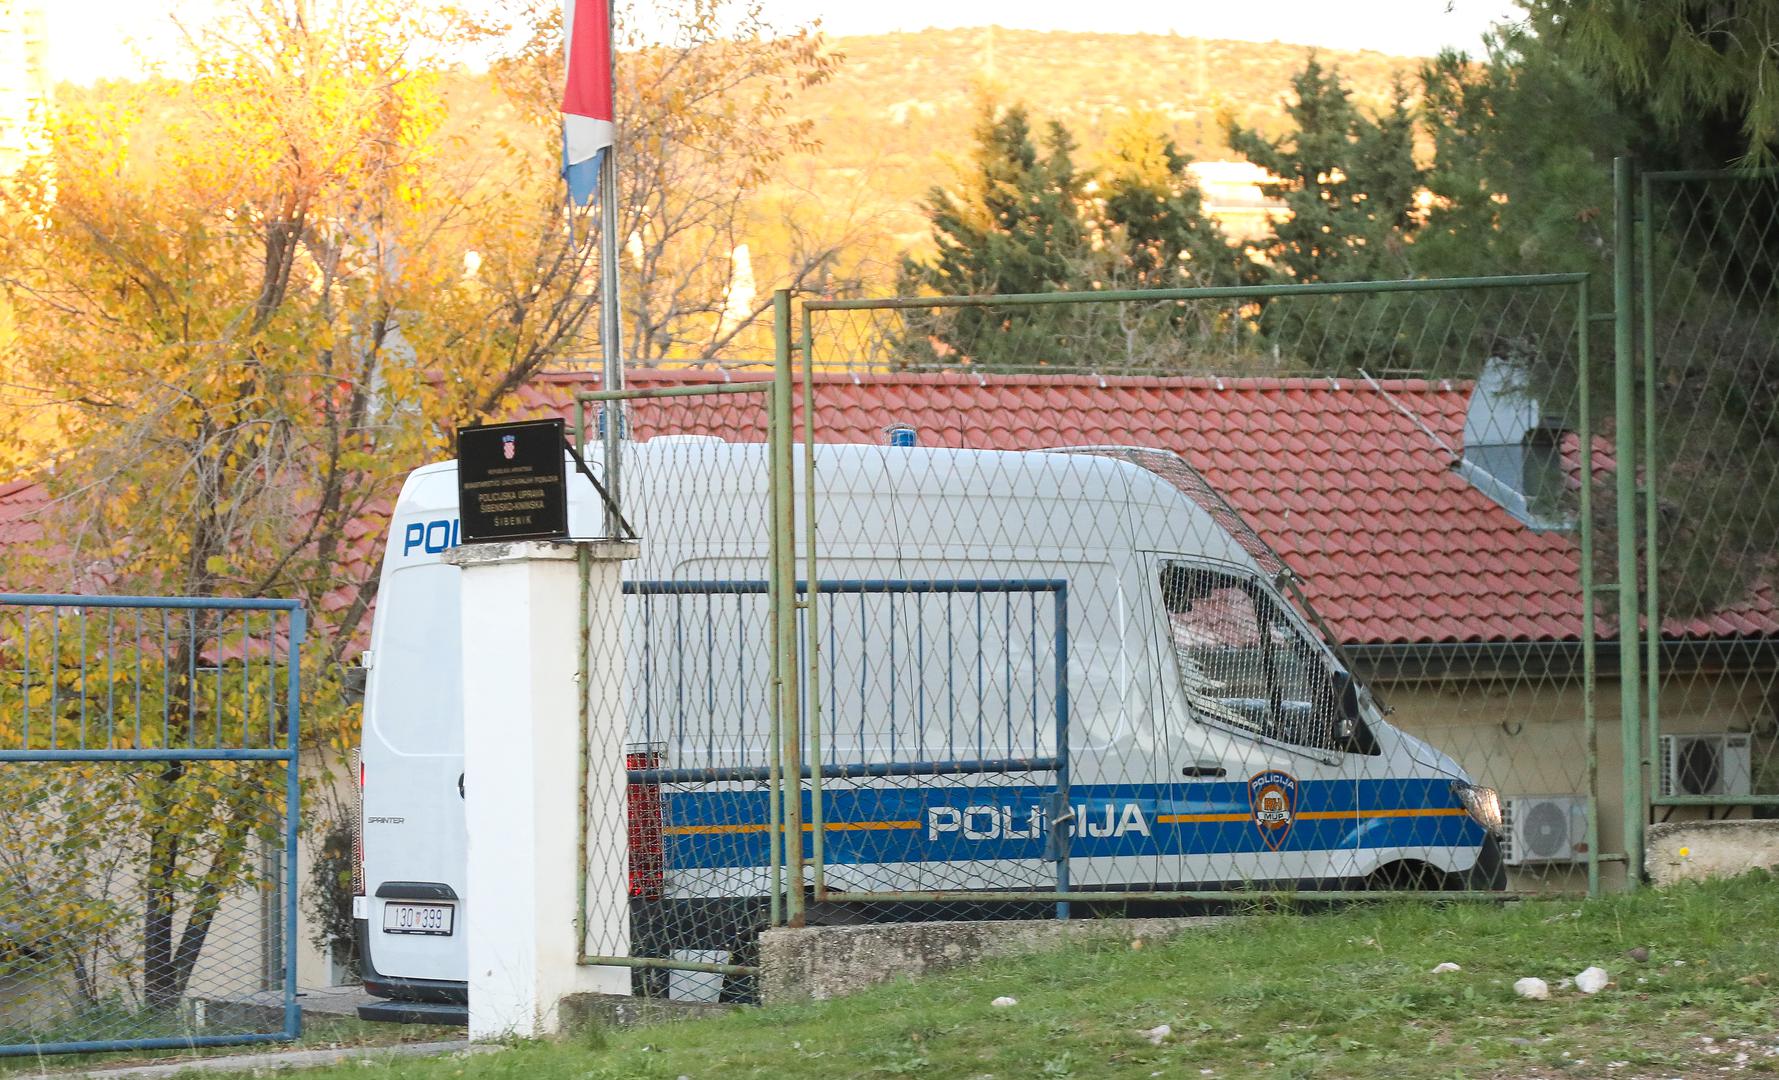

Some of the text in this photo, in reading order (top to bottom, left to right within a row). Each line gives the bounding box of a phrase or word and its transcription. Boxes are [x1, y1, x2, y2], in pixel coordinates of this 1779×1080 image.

[517, 489, 545, 499] UPRAVA
[494, 515, 532, 527] ŠIBENIK
[1252, 775, 1294, 790] POLICIJA
[367, 816, 405, 825] SPRINTER
[395, 908, 442, 929] 130 399
